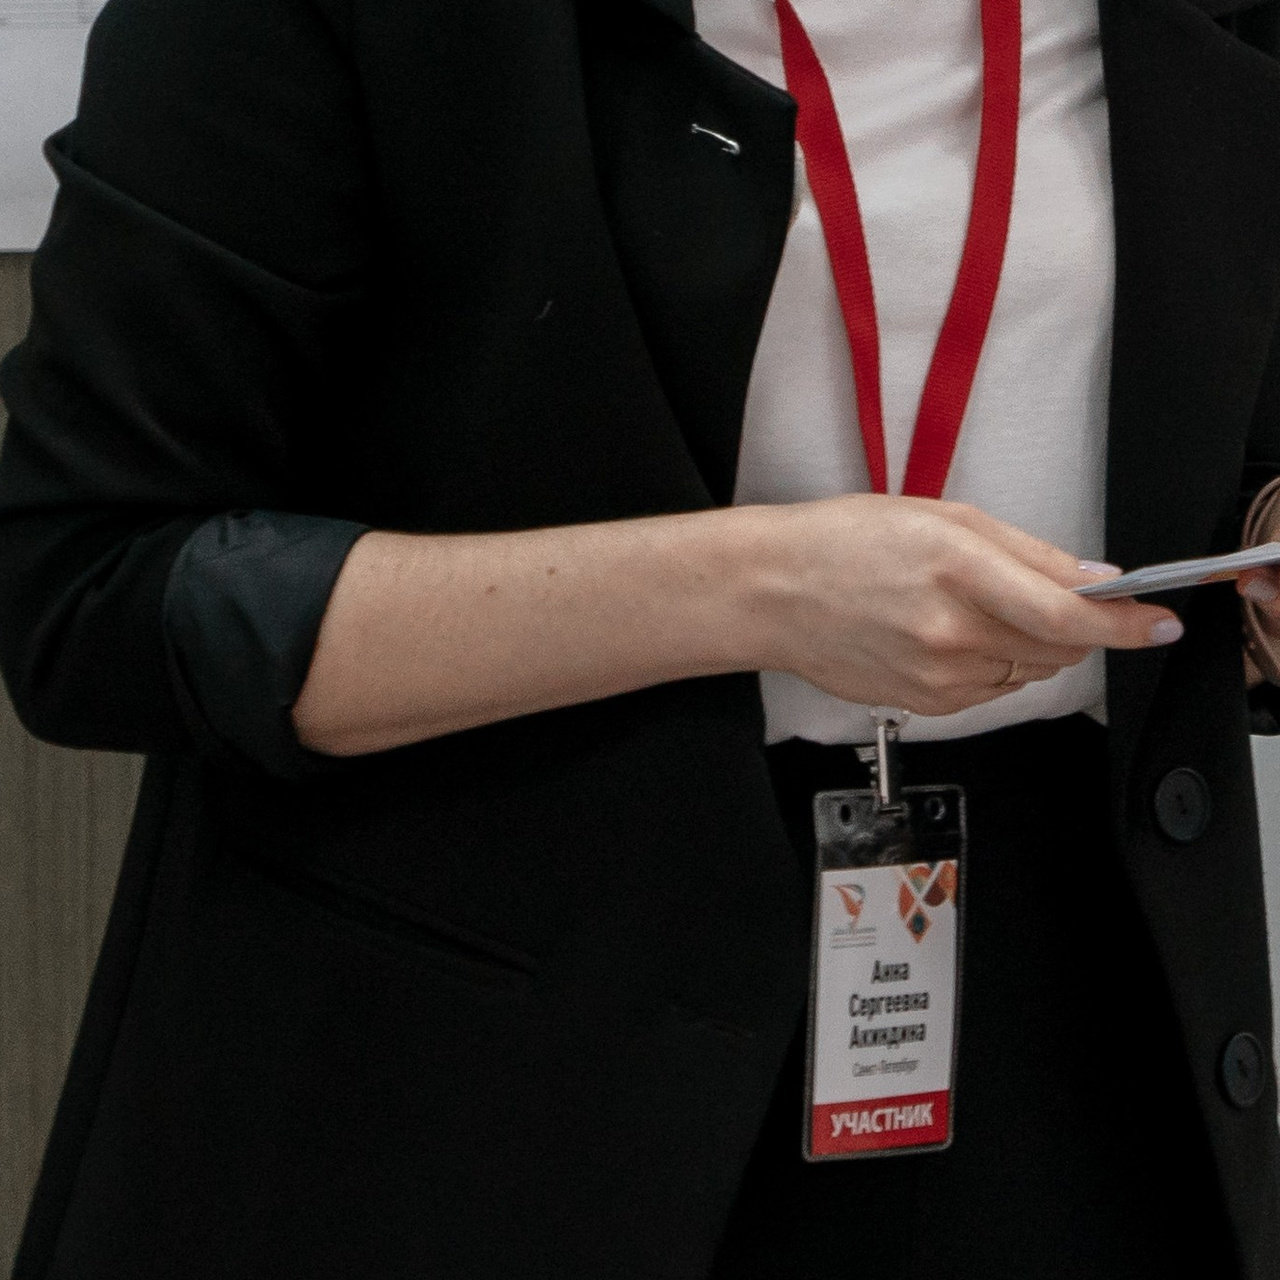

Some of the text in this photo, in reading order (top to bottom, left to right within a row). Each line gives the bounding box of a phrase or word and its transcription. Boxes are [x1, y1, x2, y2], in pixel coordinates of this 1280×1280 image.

[871, 960, 909, 984] Анна
[849, 992, 930, 1021] Сергеевна
[850, 1023, 926, 1050] Акиндина
[830, 1102, 934, 1138] УЧАСТНИК
